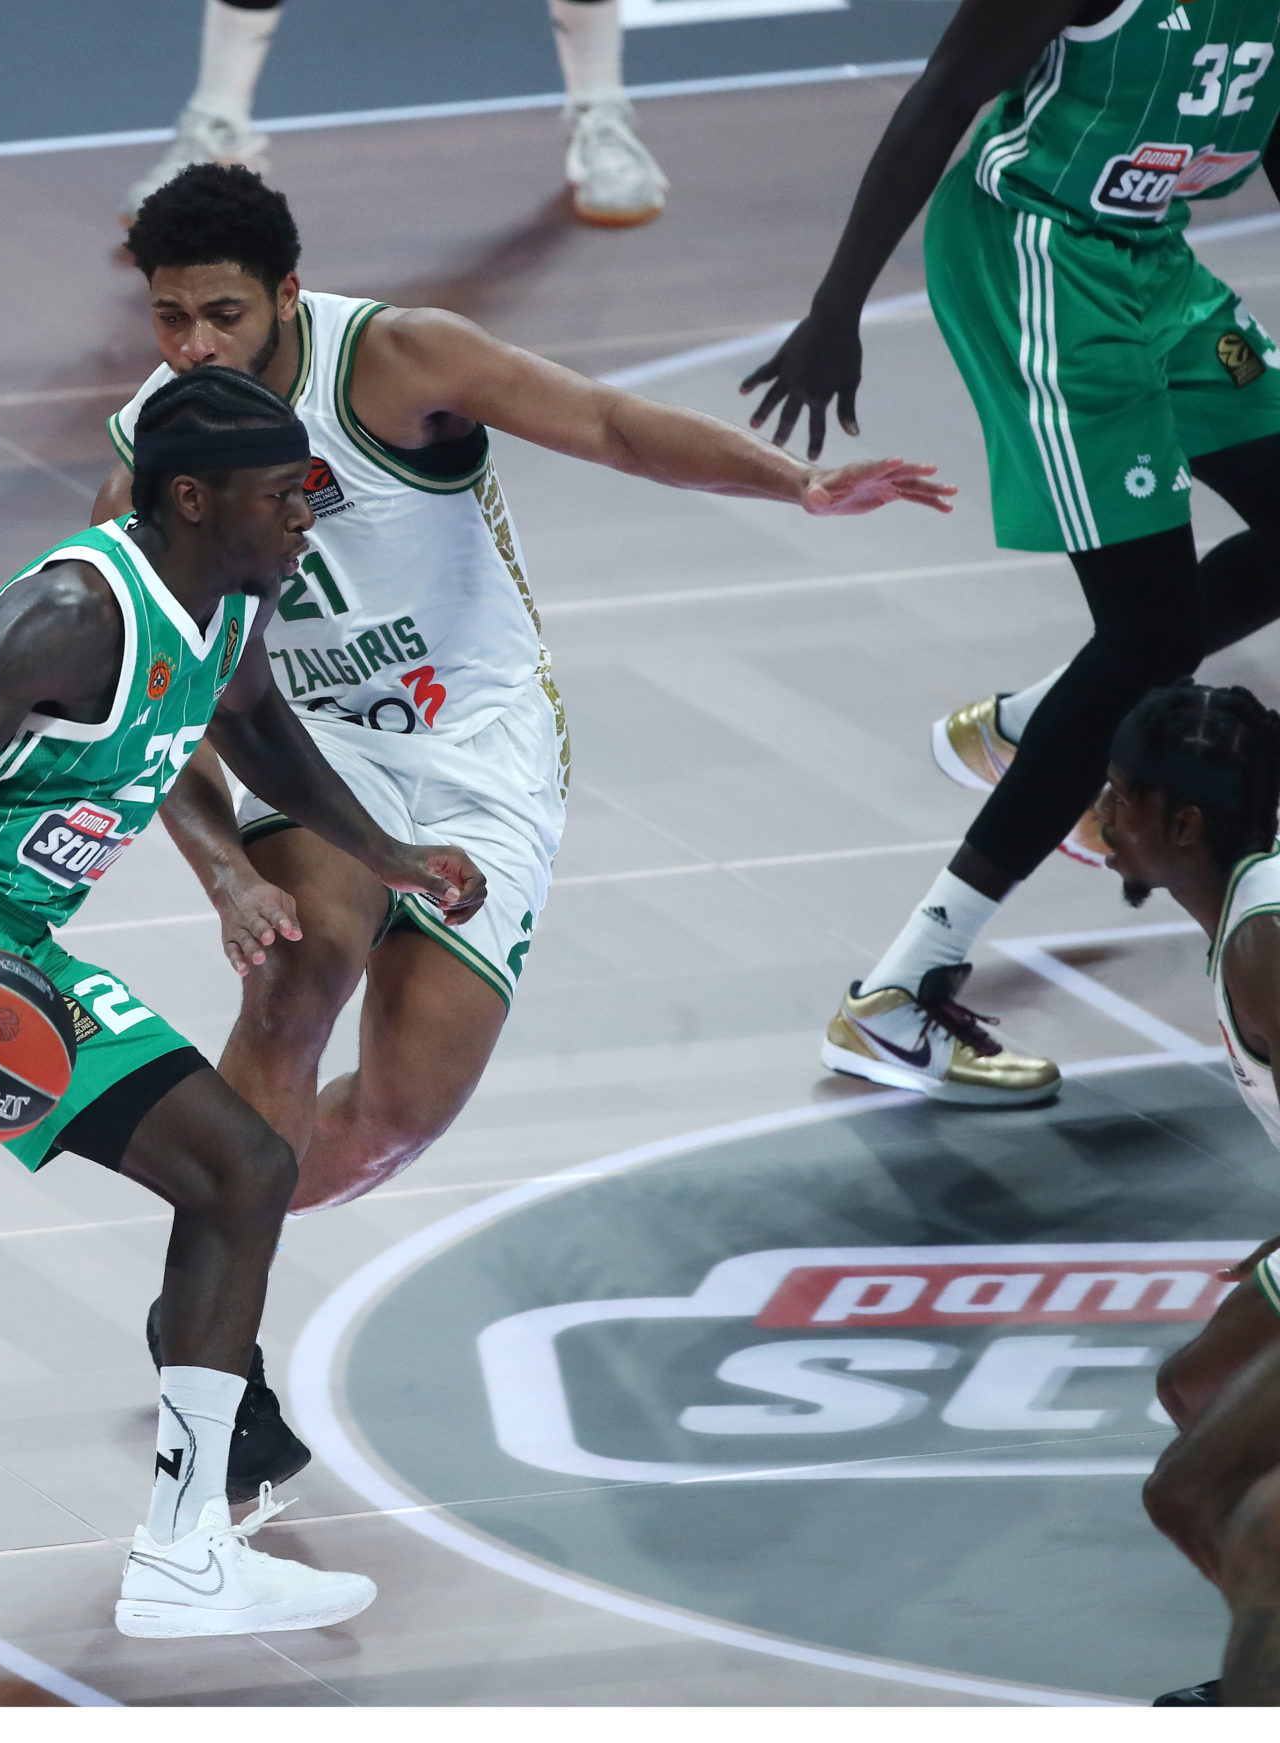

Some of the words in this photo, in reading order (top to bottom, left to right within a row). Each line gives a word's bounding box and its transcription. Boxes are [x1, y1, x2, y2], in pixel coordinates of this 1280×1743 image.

[1177, 42, 1274, 117] 32
[306, 485, 336, 499] TURKISH
[309, 490, 339, 505] AIRLINES
[278, 551, 349, 622] 21
[70, 811, 110, 834] pame
[73, 973, 157, 1035] 2
[811, 1271, 1241, 1321] pam
